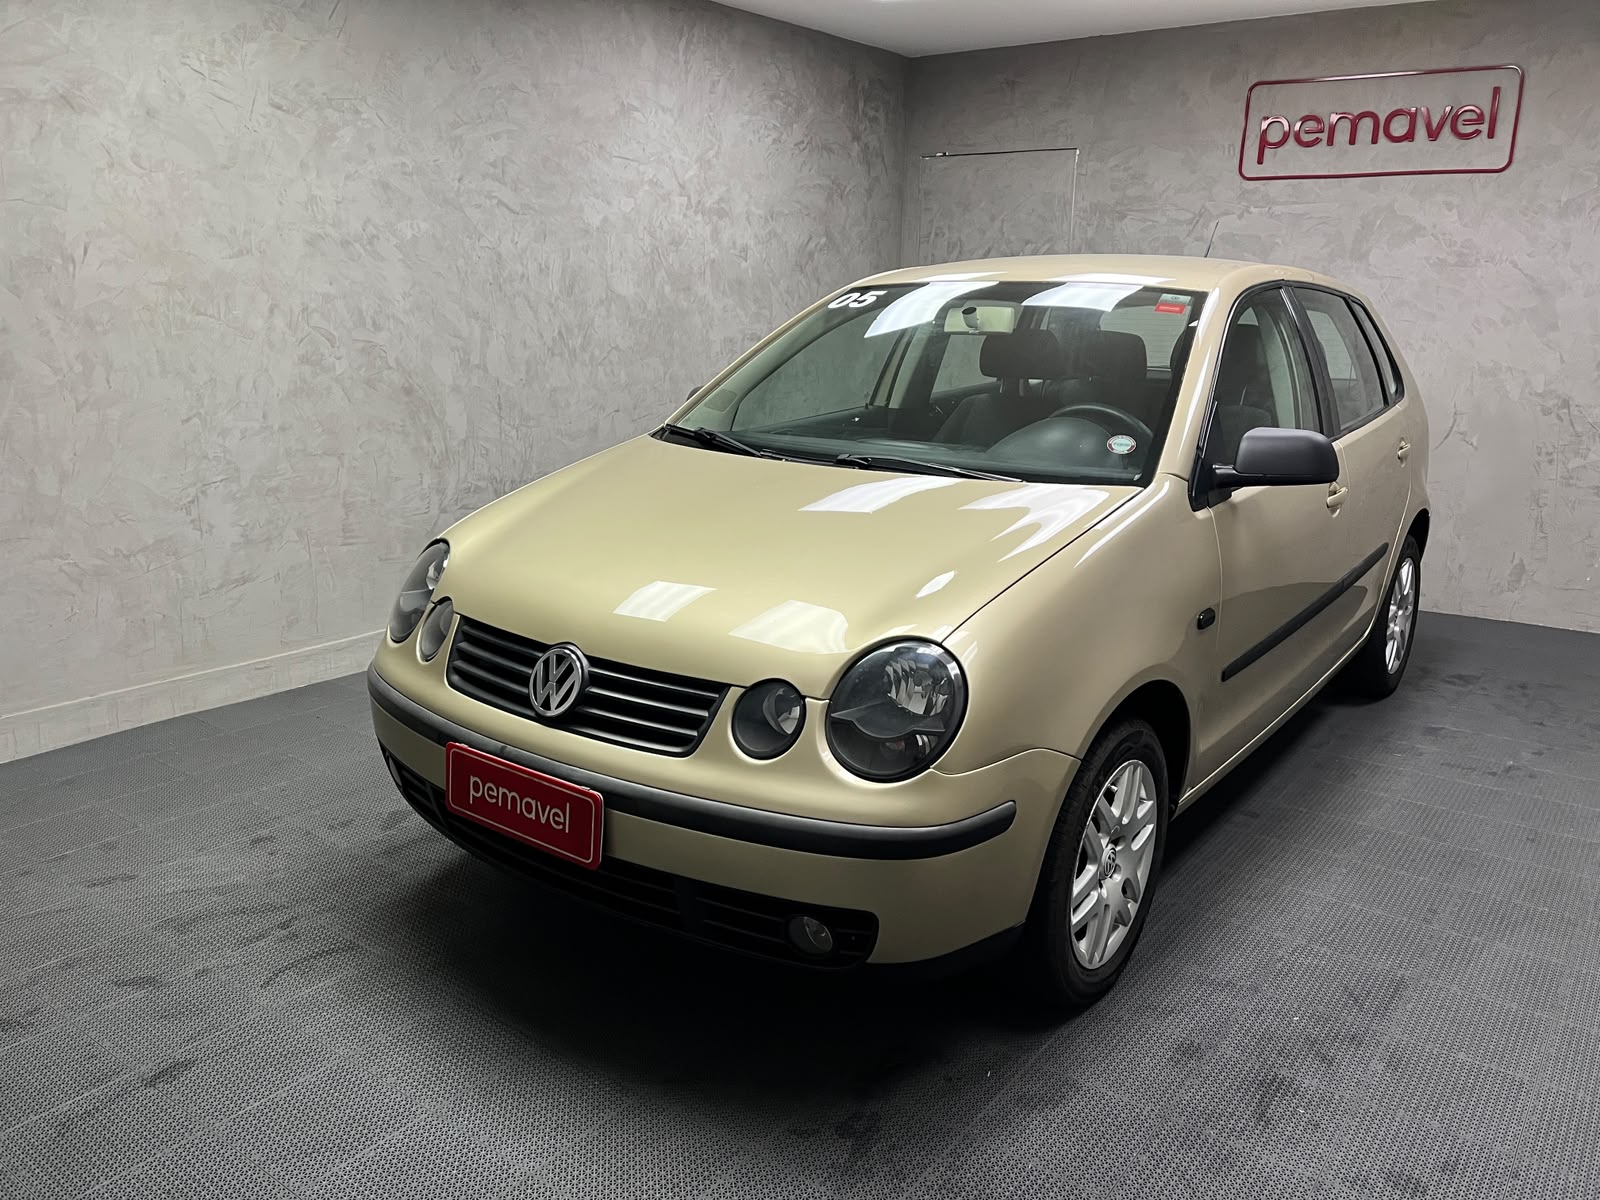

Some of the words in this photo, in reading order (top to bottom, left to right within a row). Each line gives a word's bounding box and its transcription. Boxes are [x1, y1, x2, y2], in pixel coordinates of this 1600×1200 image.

[1256, 86, 1501, 165] pemavel
[827, 290, 889, 309] 05
[534, 651, 578, 714] VW
[469, 775, 570, 834] pemavel
